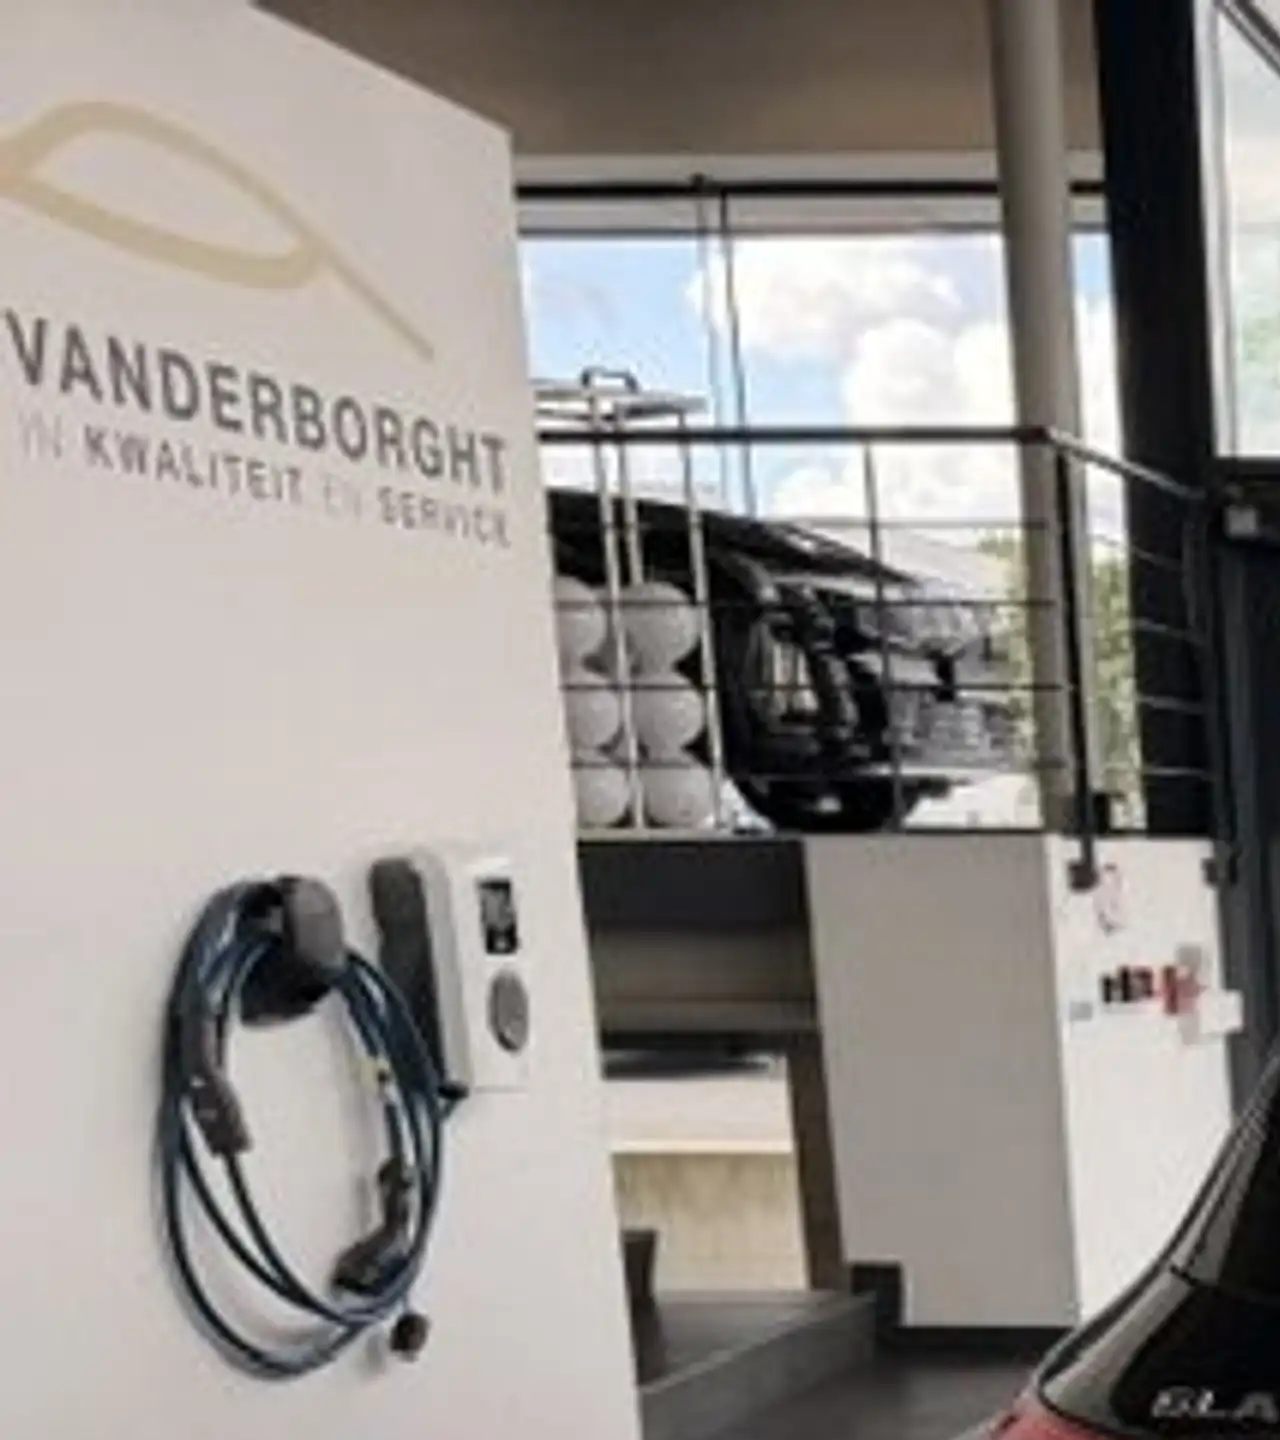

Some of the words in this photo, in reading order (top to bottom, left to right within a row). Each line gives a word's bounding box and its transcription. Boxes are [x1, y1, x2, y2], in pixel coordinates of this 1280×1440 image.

[4, 308, 508, 495] VANDERBORGHT
[83, 423, 303, 503] KWALITEIT
[377, 485, 513, 549] SERVICE
[1151, 1385, 1280, 1425] GLA
